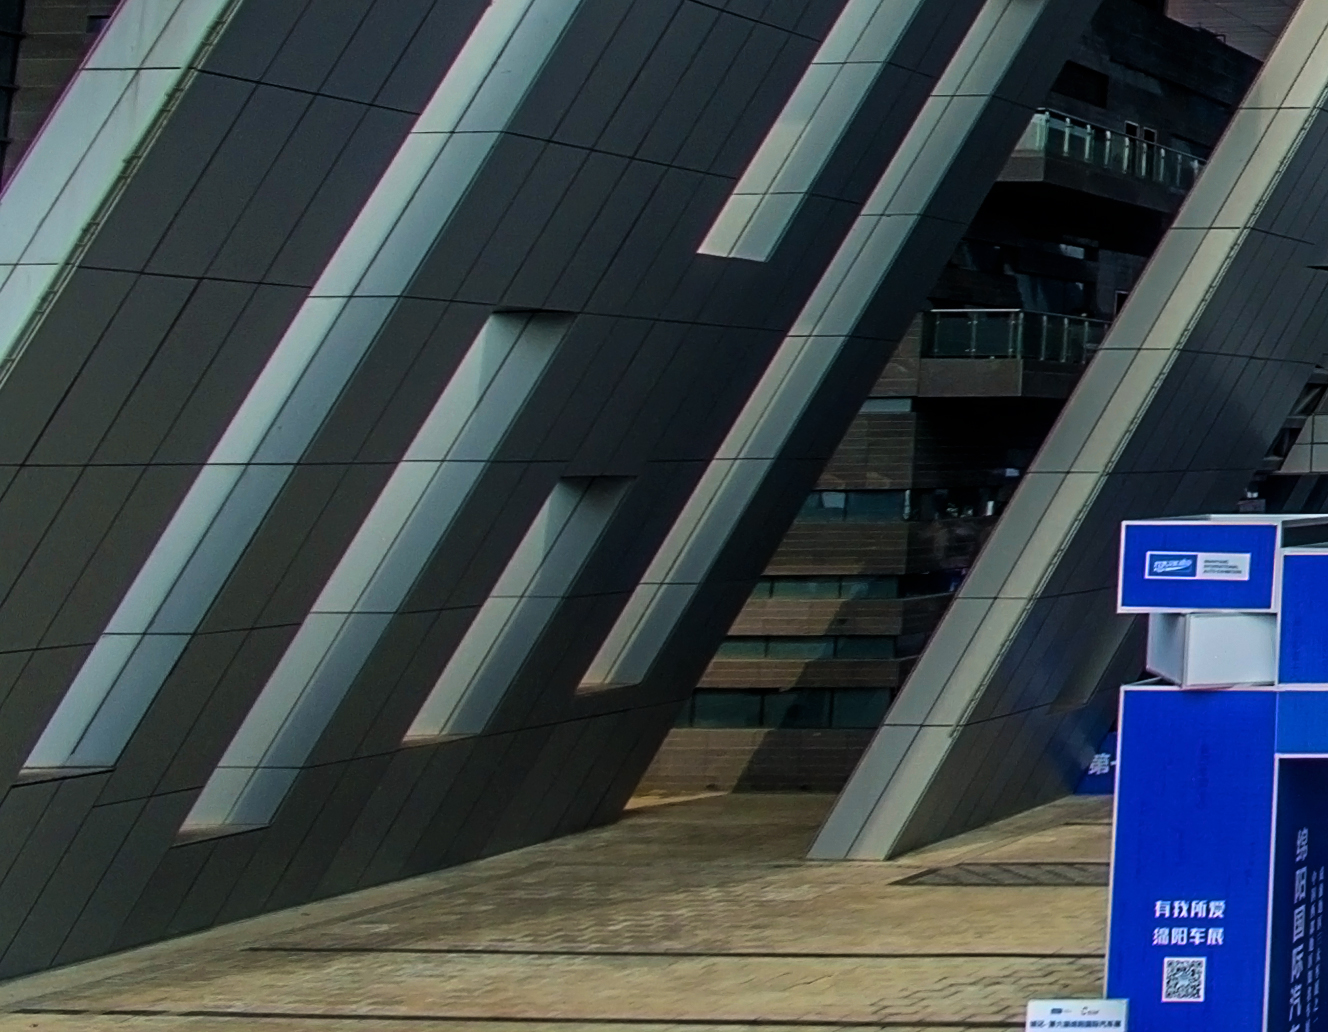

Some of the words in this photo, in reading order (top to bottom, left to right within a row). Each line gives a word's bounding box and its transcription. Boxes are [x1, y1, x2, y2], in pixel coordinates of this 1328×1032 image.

[1088, 752, 1118, 775] 第
[1153, 899, 1226, 919] 有我所爱
[1152, 927, 1224, 946] 绵阳车展
